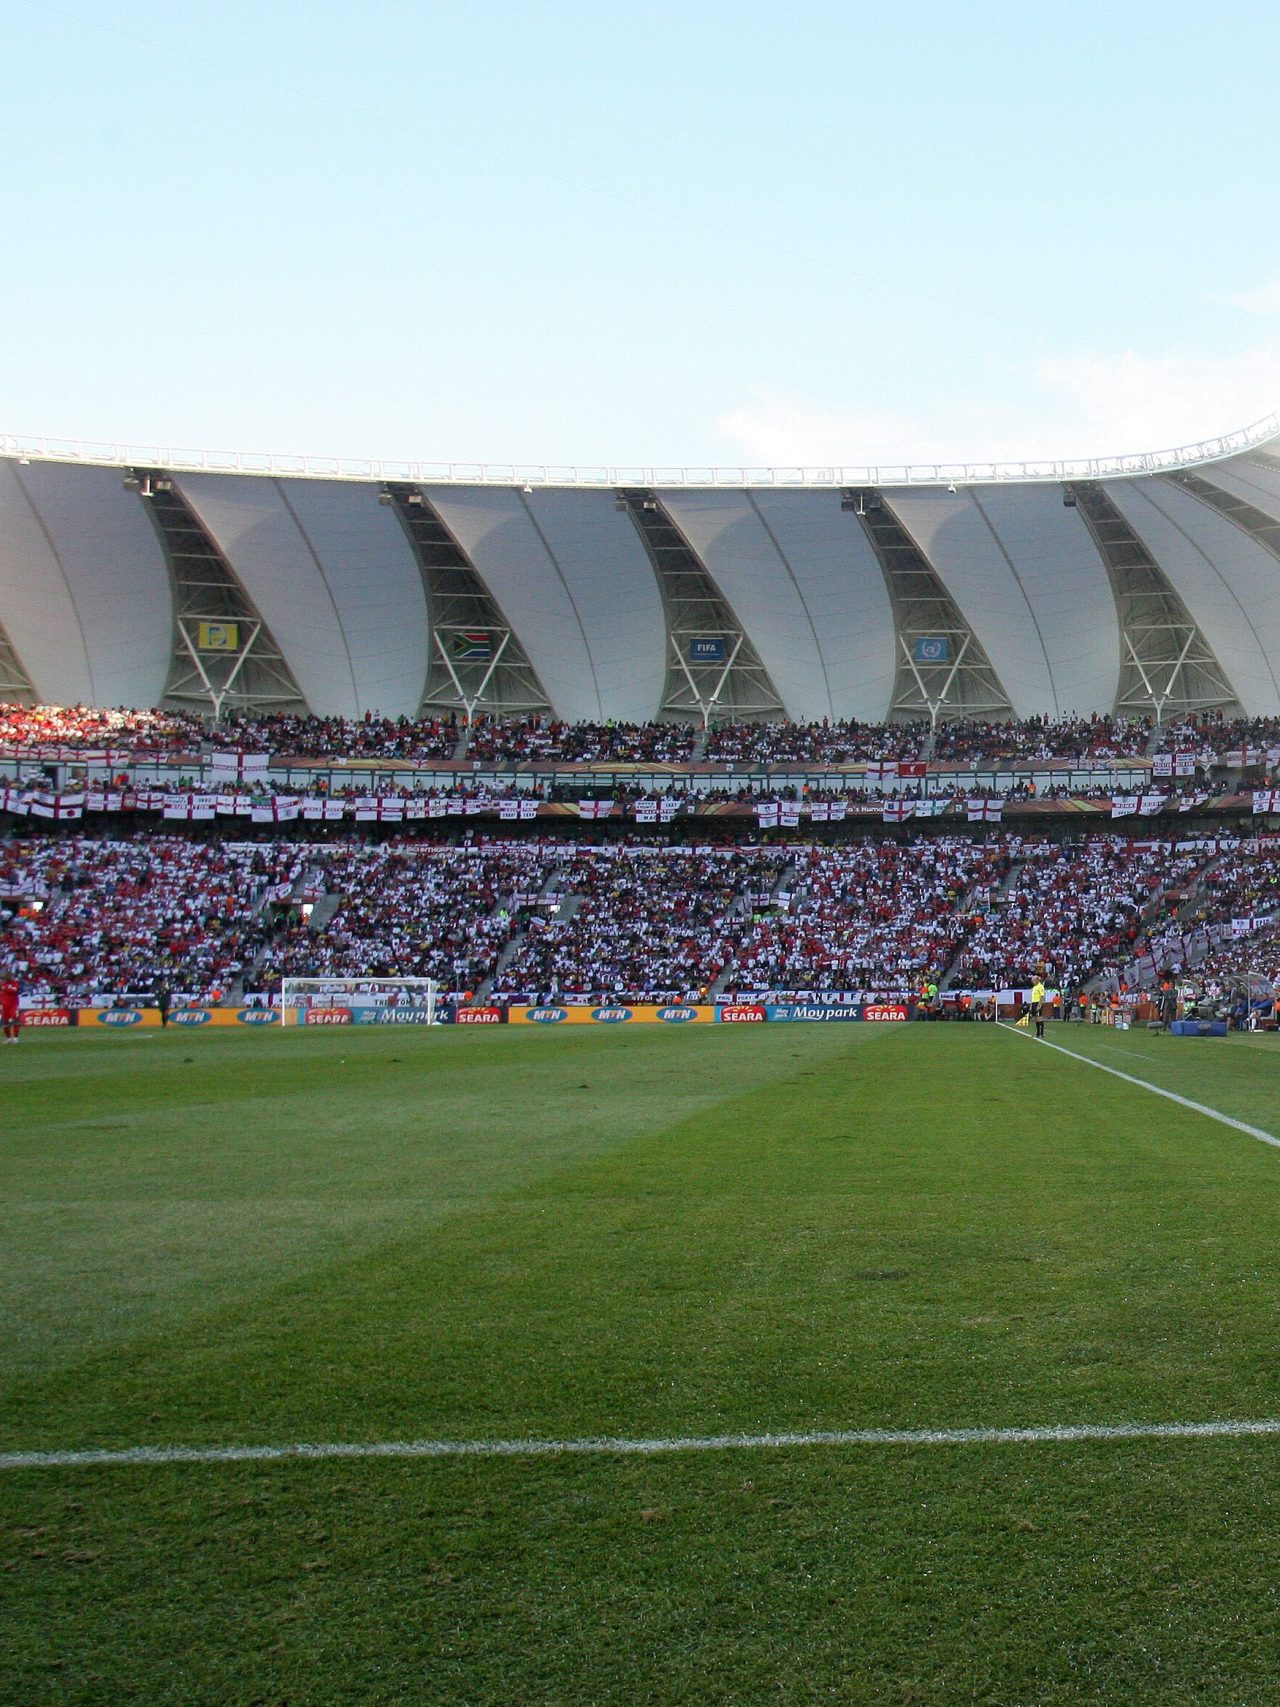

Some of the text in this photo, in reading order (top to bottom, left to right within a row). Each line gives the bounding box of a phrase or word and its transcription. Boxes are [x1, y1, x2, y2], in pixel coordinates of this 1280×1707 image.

[697, 644, 716, 652] FIFA
[105, 1012, 136, 1022] MTN
[176, 1012, 205, 1022] MTN
[245, 1011, 274, 1021] MTN
[308, 1014, 349, 1024] SEARA
[458, 1014, 500, 1023] SEARA
[533, 1010, 561, 1020] MTN
[598, 1010, 626, 1019] MTN
[663, 1009, 691, 1019] MTN
[723, 1012, 763, 1021] SEARA
[866, 1011, 906, 1020] SEARA
[25, 1016, 69, 1026] SEARA
